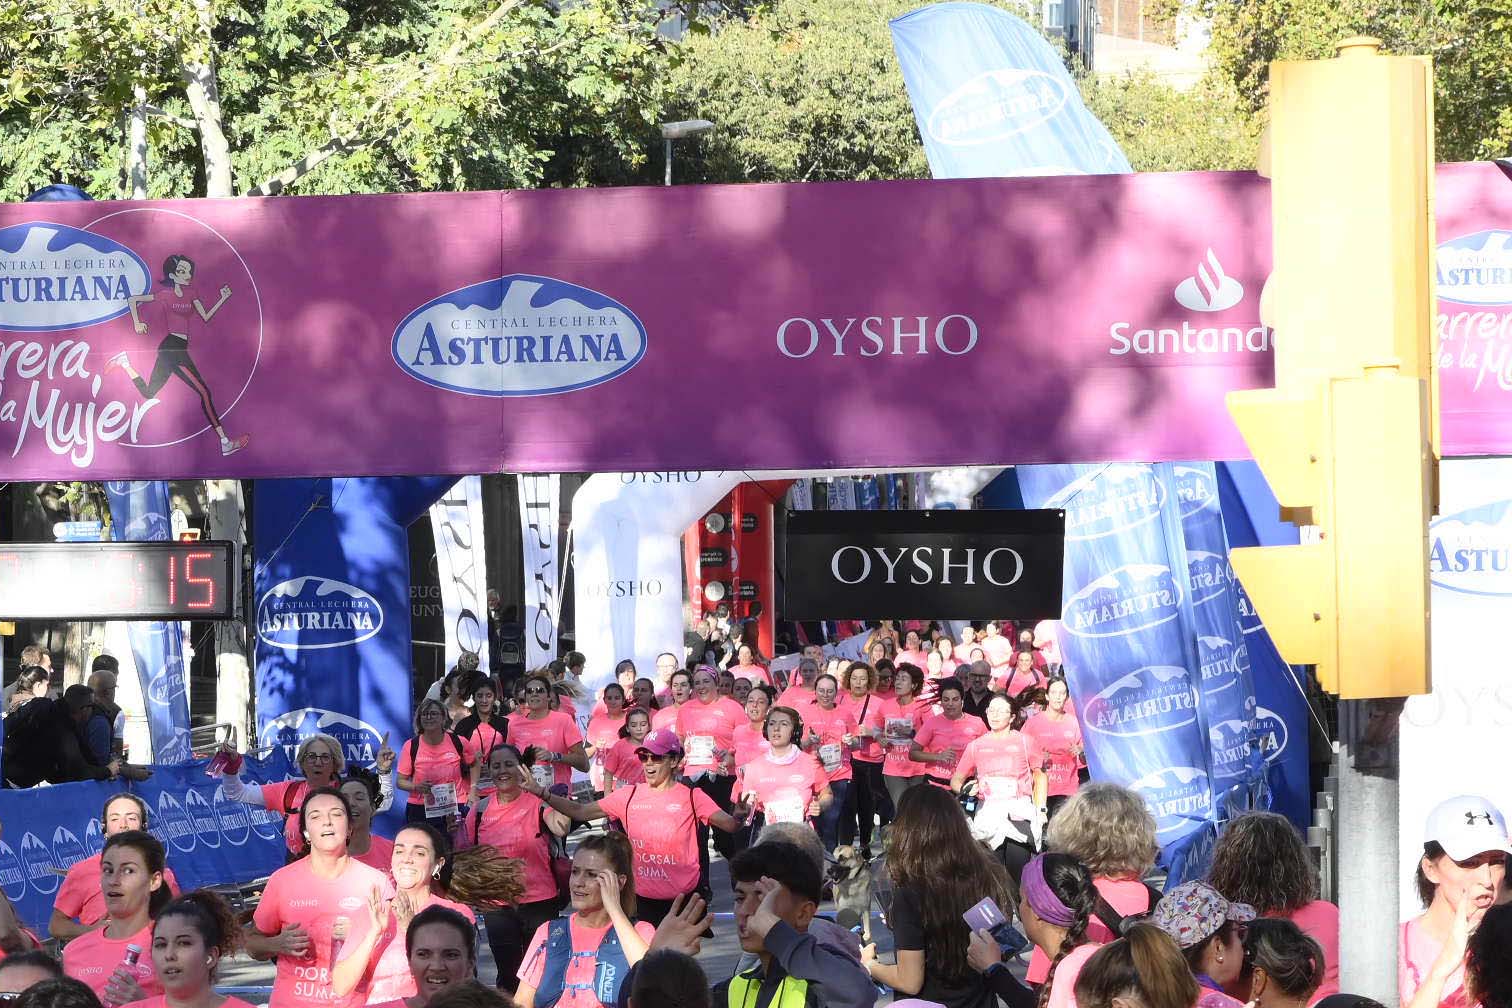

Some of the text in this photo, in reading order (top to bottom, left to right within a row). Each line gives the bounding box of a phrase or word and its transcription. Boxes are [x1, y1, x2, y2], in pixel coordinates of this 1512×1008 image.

[53, 257, 127, 270] LECHERA
[450, 315, 619, 331] CENTRAL LECHERA
[776, 313, 979, 358] OYSHO
[411, 321, 627, 367] ASTURIANA
[10, 374, 161, 469] Mujer
[830, 545, 1025, 586] OYSHO
[1428, 536, 1511, 573] ASTU
[274, 600, 370, 610] CENTRAL LECHERA
[408, 586, 440, 599] EUG
[261, 605, 375, 633] ASTURIANA
